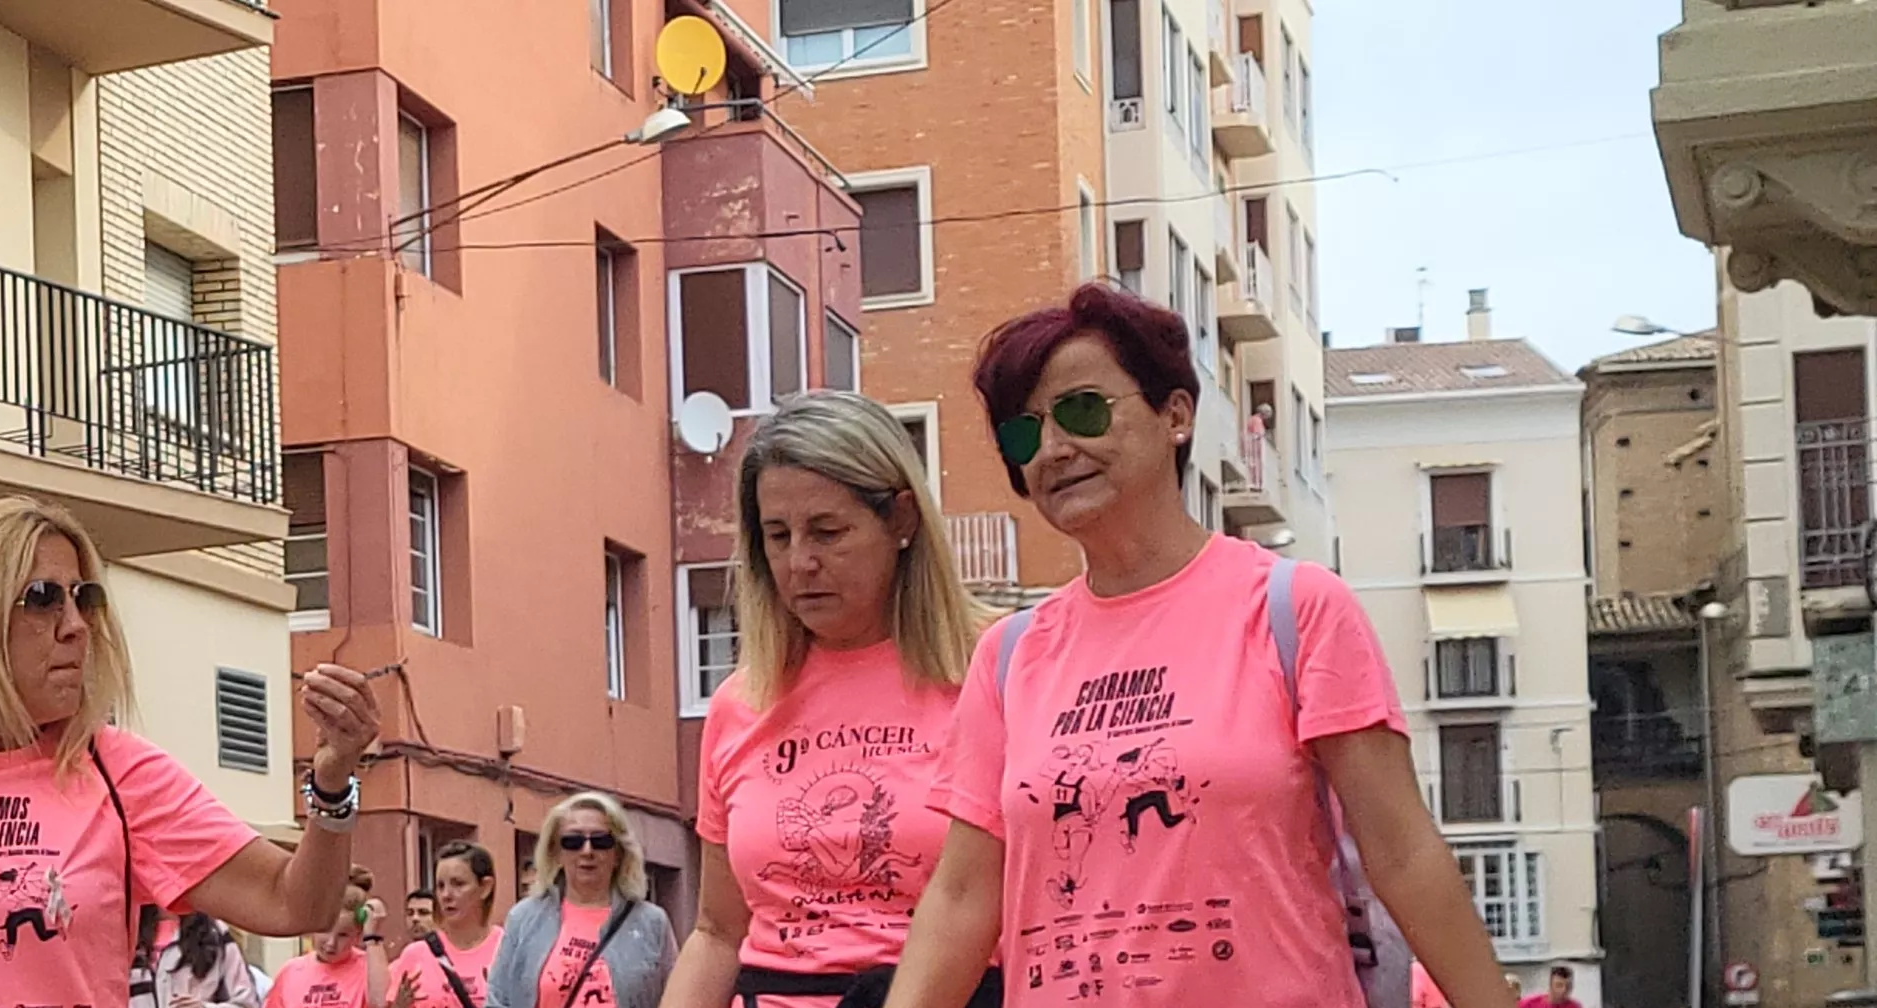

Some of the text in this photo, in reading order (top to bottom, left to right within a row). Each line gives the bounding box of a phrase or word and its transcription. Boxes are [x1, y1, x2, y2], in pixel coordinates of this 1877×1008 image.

[1084, 702, 1108, 732] LA
[1108, 691, 1175, 728] CIENCIA
[815, 720, 916, 750] CÁNCER
